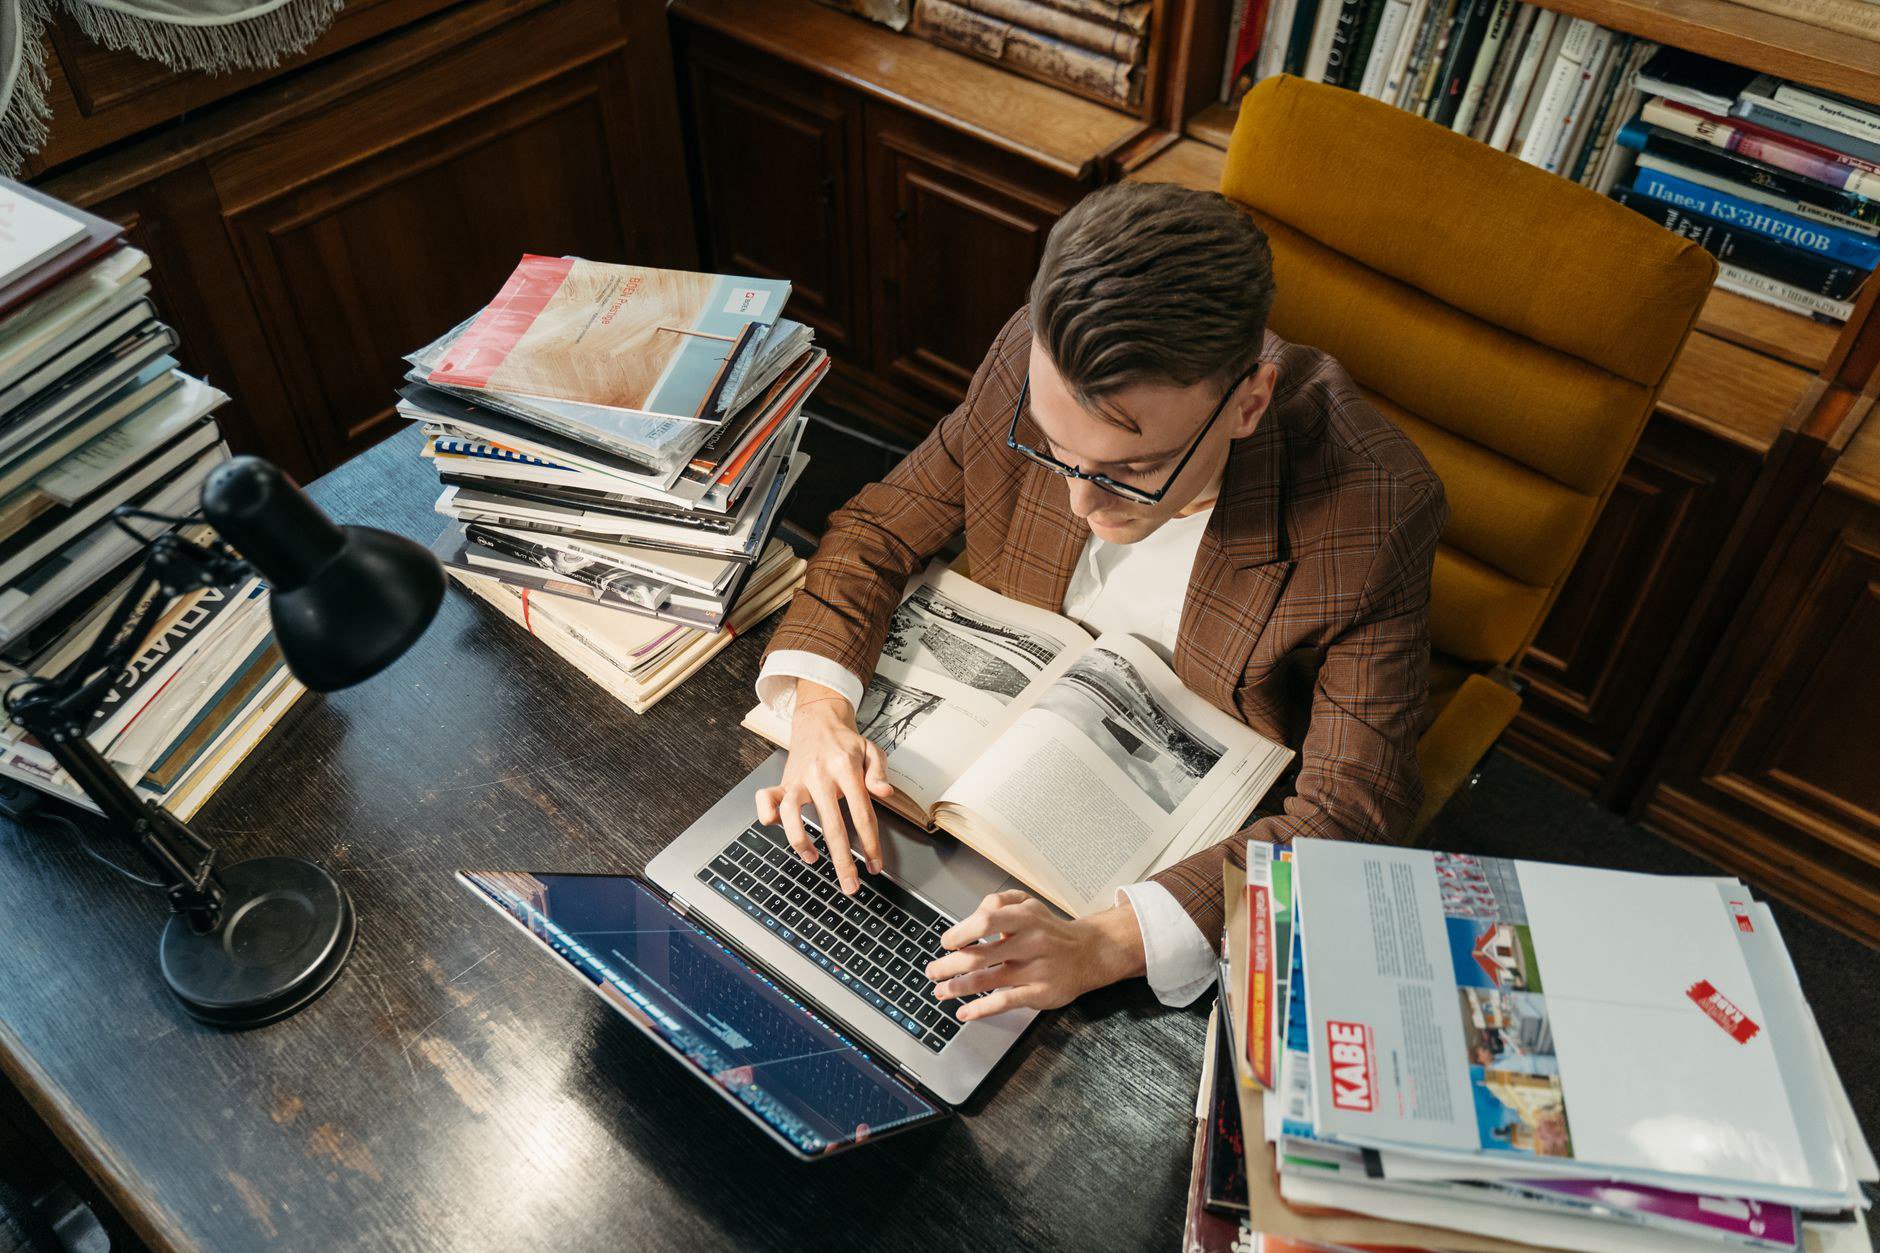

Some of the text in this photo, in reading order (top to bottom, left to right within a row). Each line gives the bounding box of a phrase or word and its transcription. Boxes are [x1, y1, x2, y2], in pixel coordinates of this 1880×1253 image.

[1648, 181, 1705, 212] Павел
[1711, 200, 1831, 252] КУЗНЕЦОВ
[1330, 1023, 1370, 1107] KABE
